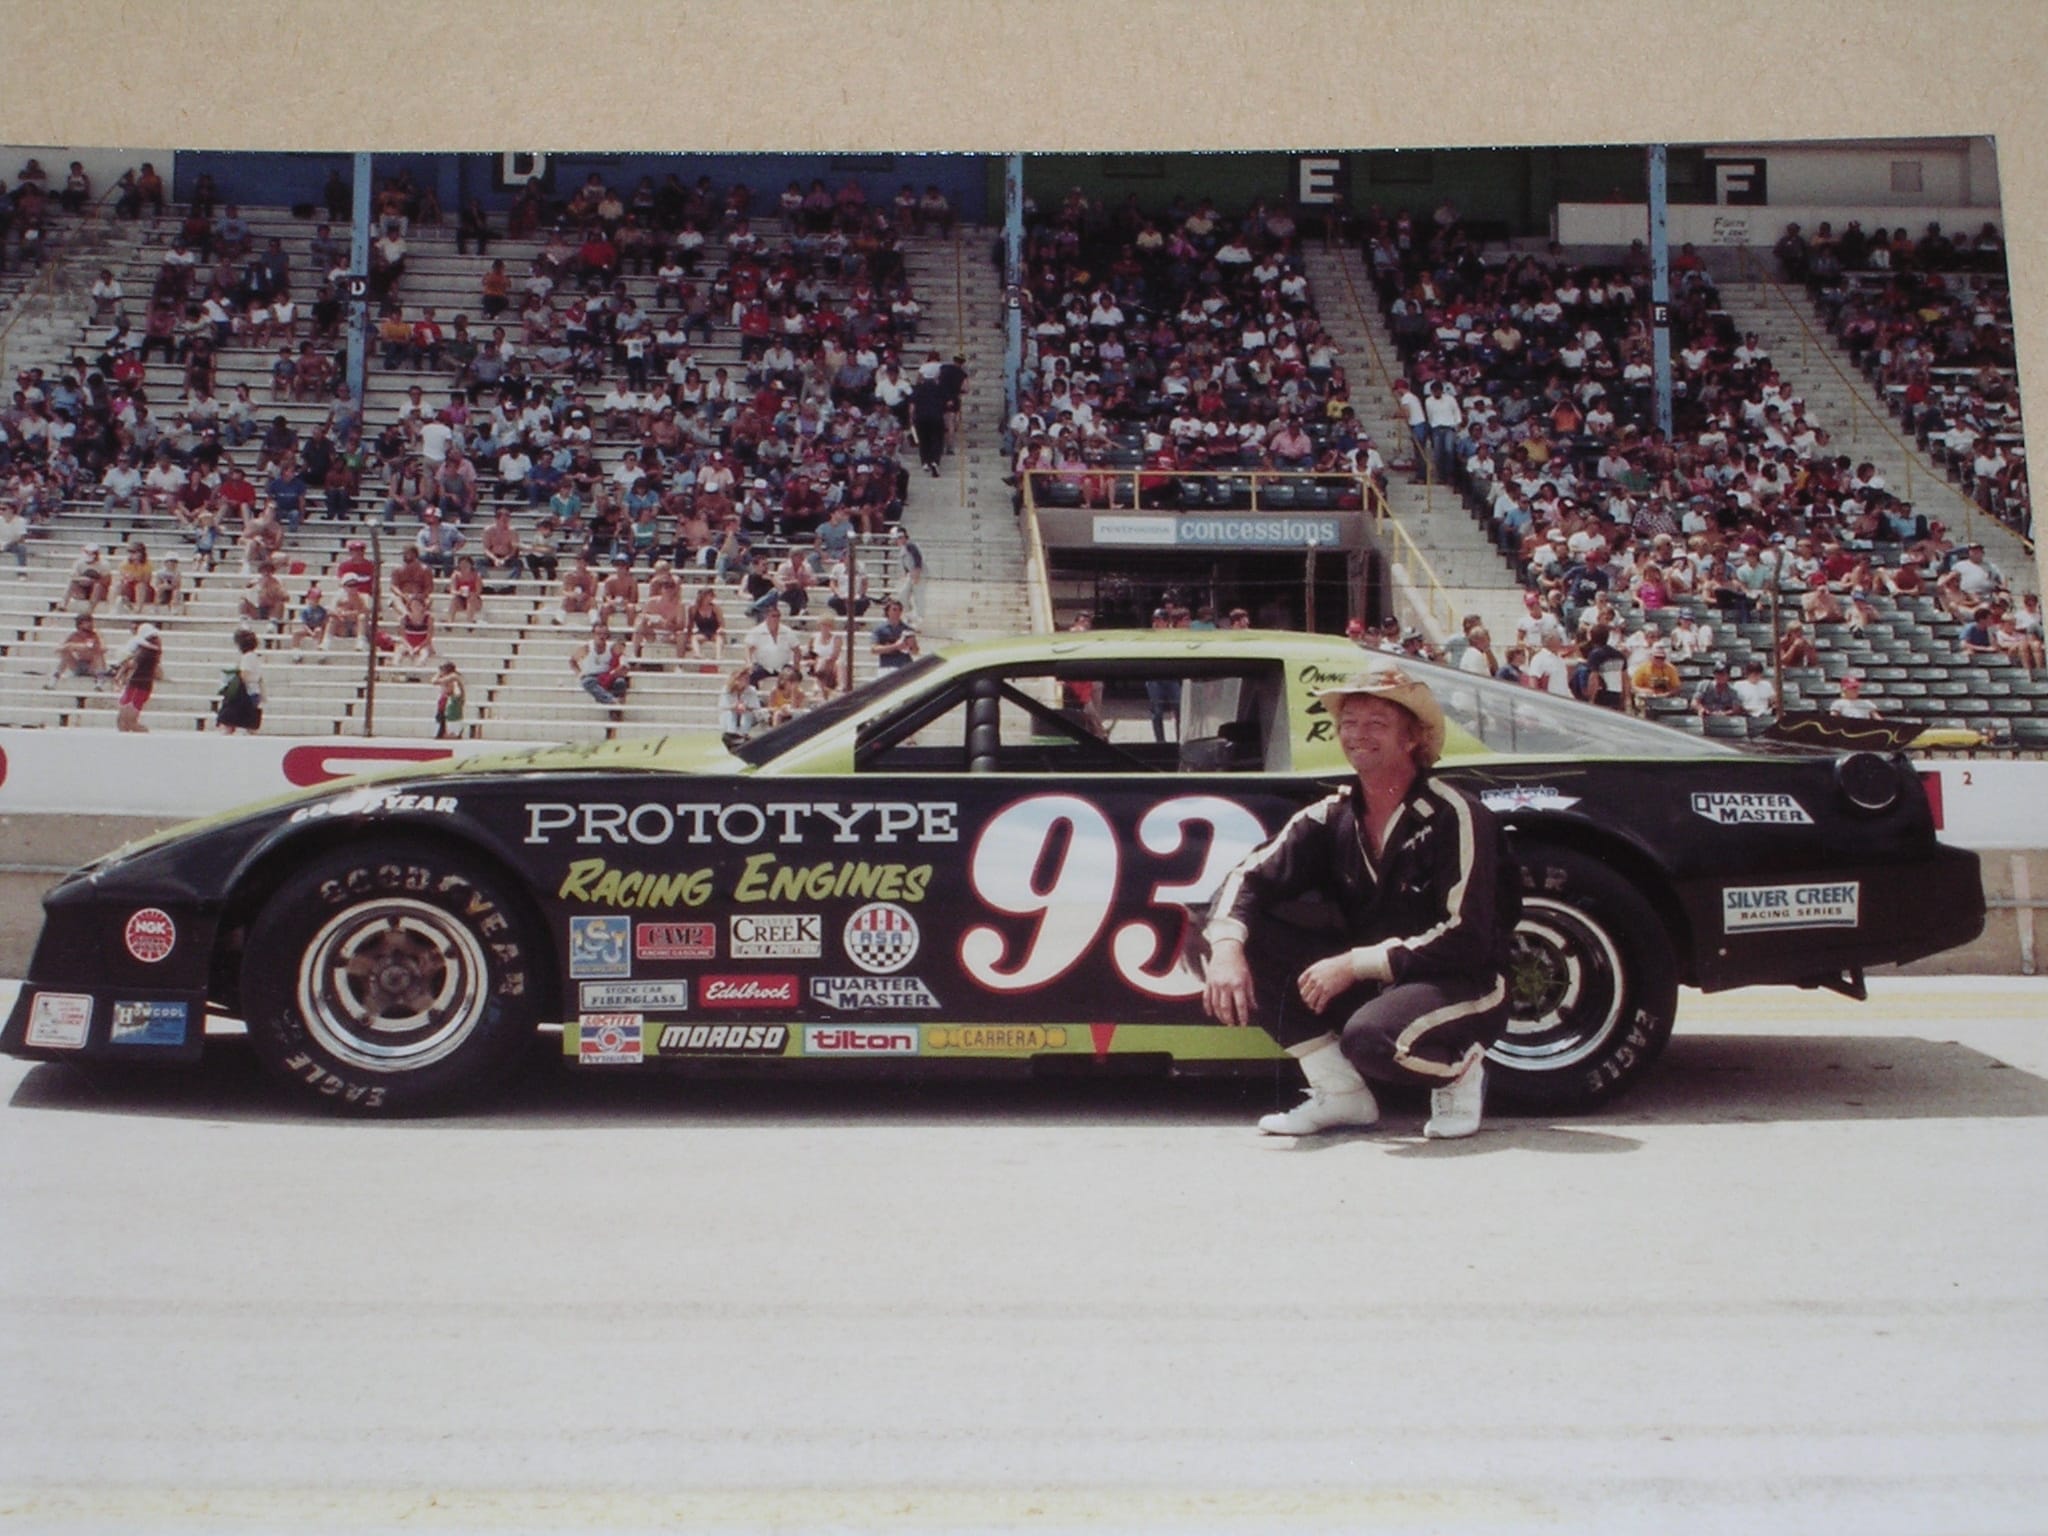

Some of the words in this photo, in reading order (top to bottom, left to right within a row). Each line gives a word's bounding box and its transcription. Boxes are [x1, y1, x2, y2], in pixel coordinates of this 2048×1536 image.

[503, 153, 546, 185] D
[1300, 159, 1340, 203] E
[1716, 165, 1755, 206] F
[1181, 519, 1334, 540] concessions
[1962, 771, 1973, 786] 2
[1694, 794, 1792, 813] QUARTER
[523, 803, 959, 844] PROTOTYPE
[1720, 808, 1805, 823] MASTER
[559, 857, 714, 908] RACING
[733, 852, 934, 903] ENGINES
[958, 791, 1268, 1002] 93
[1727, 890, 1789, 909] SILVER
[1795, 886, 1855, 904] CREEK
[1741, 909, 1790, 920] RACING
[1797, 907, 1843, 917] SERIES
[136, 921, 167, 933] NGK
[733, 917, 820, 943] CREEK
[860, 931, 903, 945] ASA
[605, 986, 637, 994] STOCK
[706, 980, 791, 1000] Edelbrock
[812, 979, 920, 999] QUARTER
[591, 995, 677, 1005] FIBERGLASS
[838, 993, 931, 1009] MASTER
[584, 1015, 637, 1026] LOCTITE
[660, 1026, 786, 1048] MOROSO
[812, 1030, 912, 1050] tilton
[963, 1029, 1038, 1047] CARRERA
